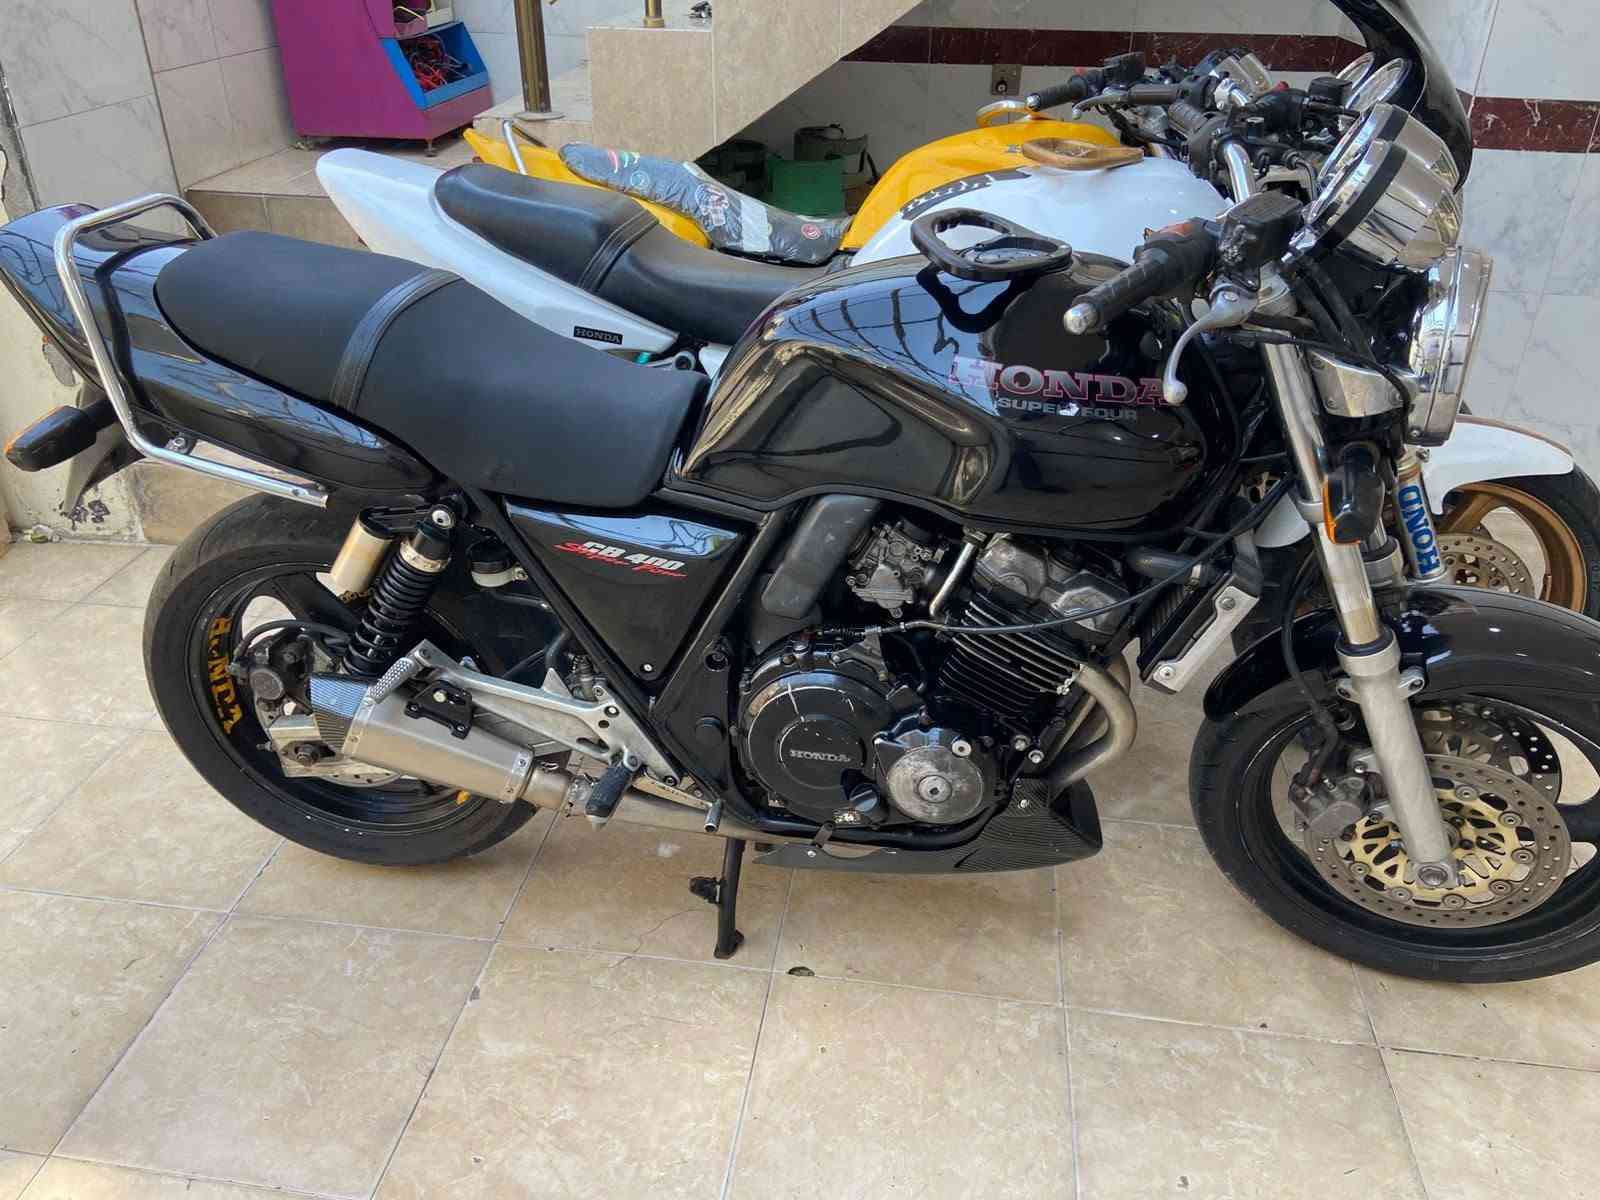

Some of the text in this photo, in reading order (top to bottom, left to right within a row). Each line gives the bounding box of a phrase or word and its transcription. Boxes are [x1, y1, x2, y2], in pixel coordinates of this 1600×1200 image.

[575, 328, 621, 343] HONDA
[948, 355, 1170, 408] HONDA
[998, 398, 1137, 422] SUPE FOUR
[624, 553, 685, 571] 400
[790, 749, 851, 762] HONDA
